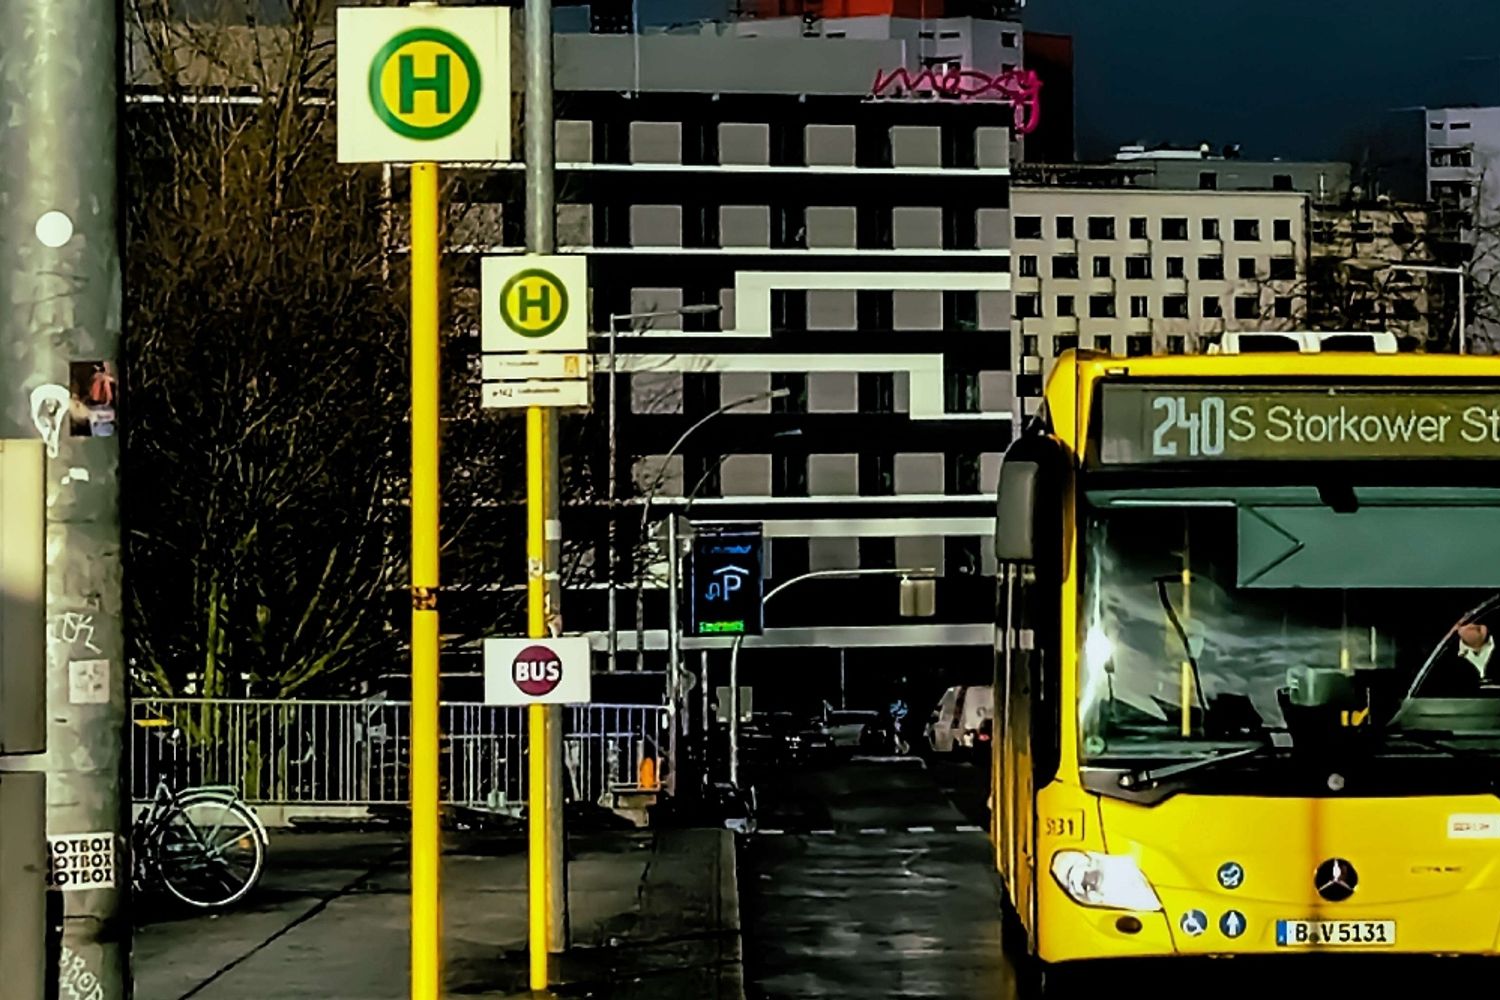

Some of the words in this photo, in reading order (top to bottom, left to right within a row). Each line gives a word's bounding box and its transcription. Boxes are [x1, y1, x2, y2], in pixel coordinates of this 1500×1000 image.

[399, 54, 450, 114] H
[518, 284, 551, 322] H
[1152, 396, 1225, 456] 240
[1228, 405, 1256, 442] S
[1264, 404, 1452, 443] Storkower
[515, 660, 560, 682] BUS
[1295, 923, 1308, 942] B
[1338, 923, 1387, 942] 5131
